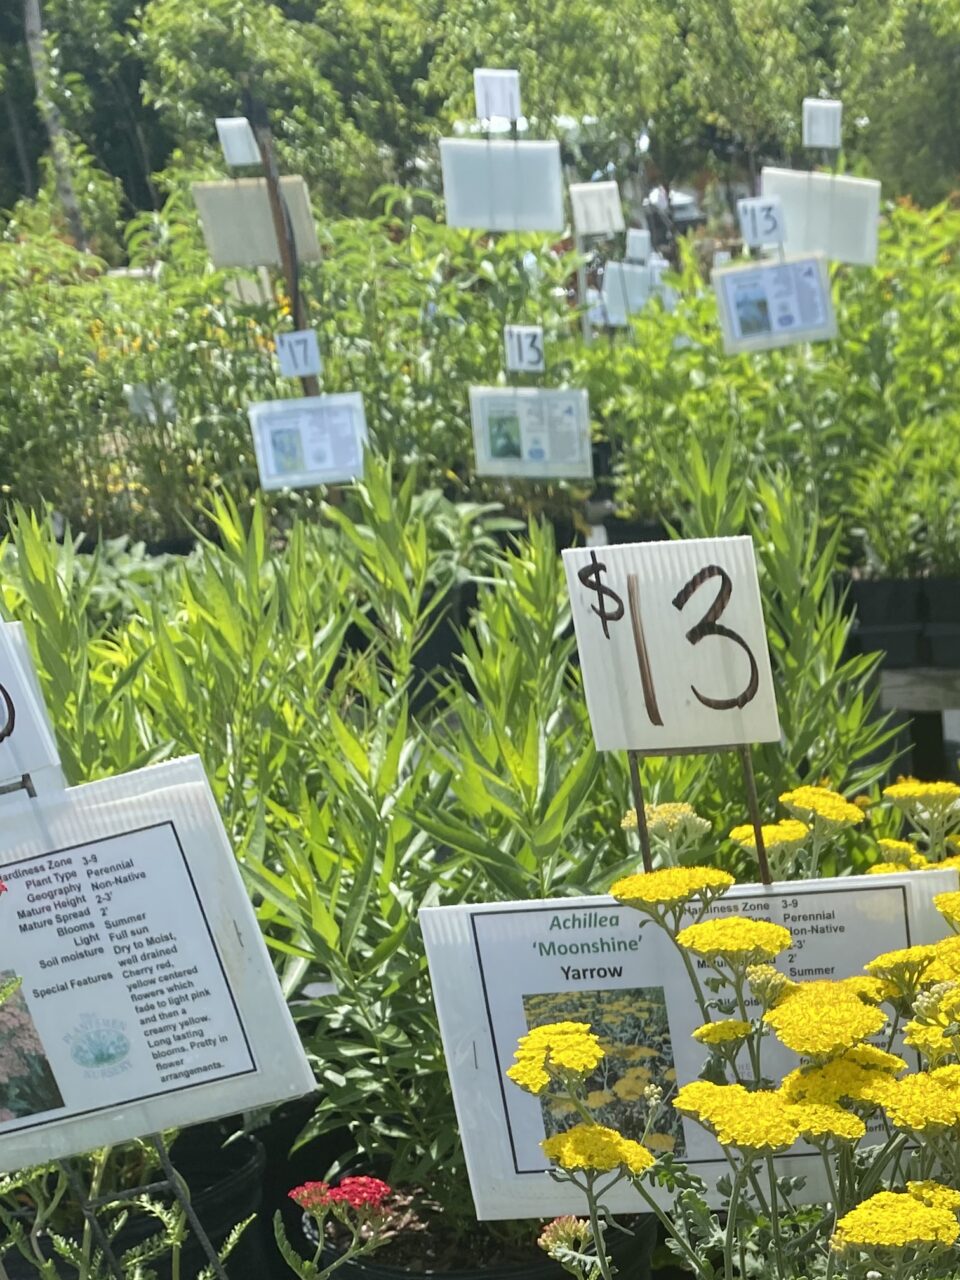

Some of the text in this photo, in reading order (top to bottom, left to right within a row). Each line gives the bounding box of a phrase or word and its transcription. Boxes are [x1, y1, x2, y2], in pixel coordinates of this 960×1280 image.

[578, 550, 758, 726] $13
[0, 854, 98, 882] ardiness Zone 3-9
[25, 858, 135, 889] Plant Type Perennial
[27, 871, 146, 903] Geography Non-Native
[17, 905, 52, 919] Mature
[53, 895, 87, 910] Height
[742, 901, 770, 912] Zone
[782, 899, 798, 909] 3-9
[783, 909, 835, 922] Perennial
[19, 919, 53, 933] Mature
[55, 907, 91, 924] Spread
[57, 912, 147, 937] Blooms Summer
[550, 912, 620, 931] Achillea
[73, 925, 149, 947] Light Full sun
[533, 935, 643, 957] ‘Moonshine’
[39, 932, 177, 969] Soil moisture Dry to Moist,
[118, 945, 178, 968] well drained
[32, 960, 174, 999] Special Features Cherry red,
[126, 966, 198, 993] yellow centered
[561, 965, 623, 981] Yarrow
[789, 967, 835, 977] Summer
[130, 980, 194, 1003] flowers which
[135, 988, 211, 1014] fade to light pink
[139, 1007, 187, 1026] and then a
[144, 1013, 211, 1038] creamy yellow.
[147, 1028, 204, 1049] Long lasting
[151, 1034, 228, 1060] blooms. Pretty in
[156, 1058, 184, 1071] flower
[160, 1062, 224, 1083] arrangements.
